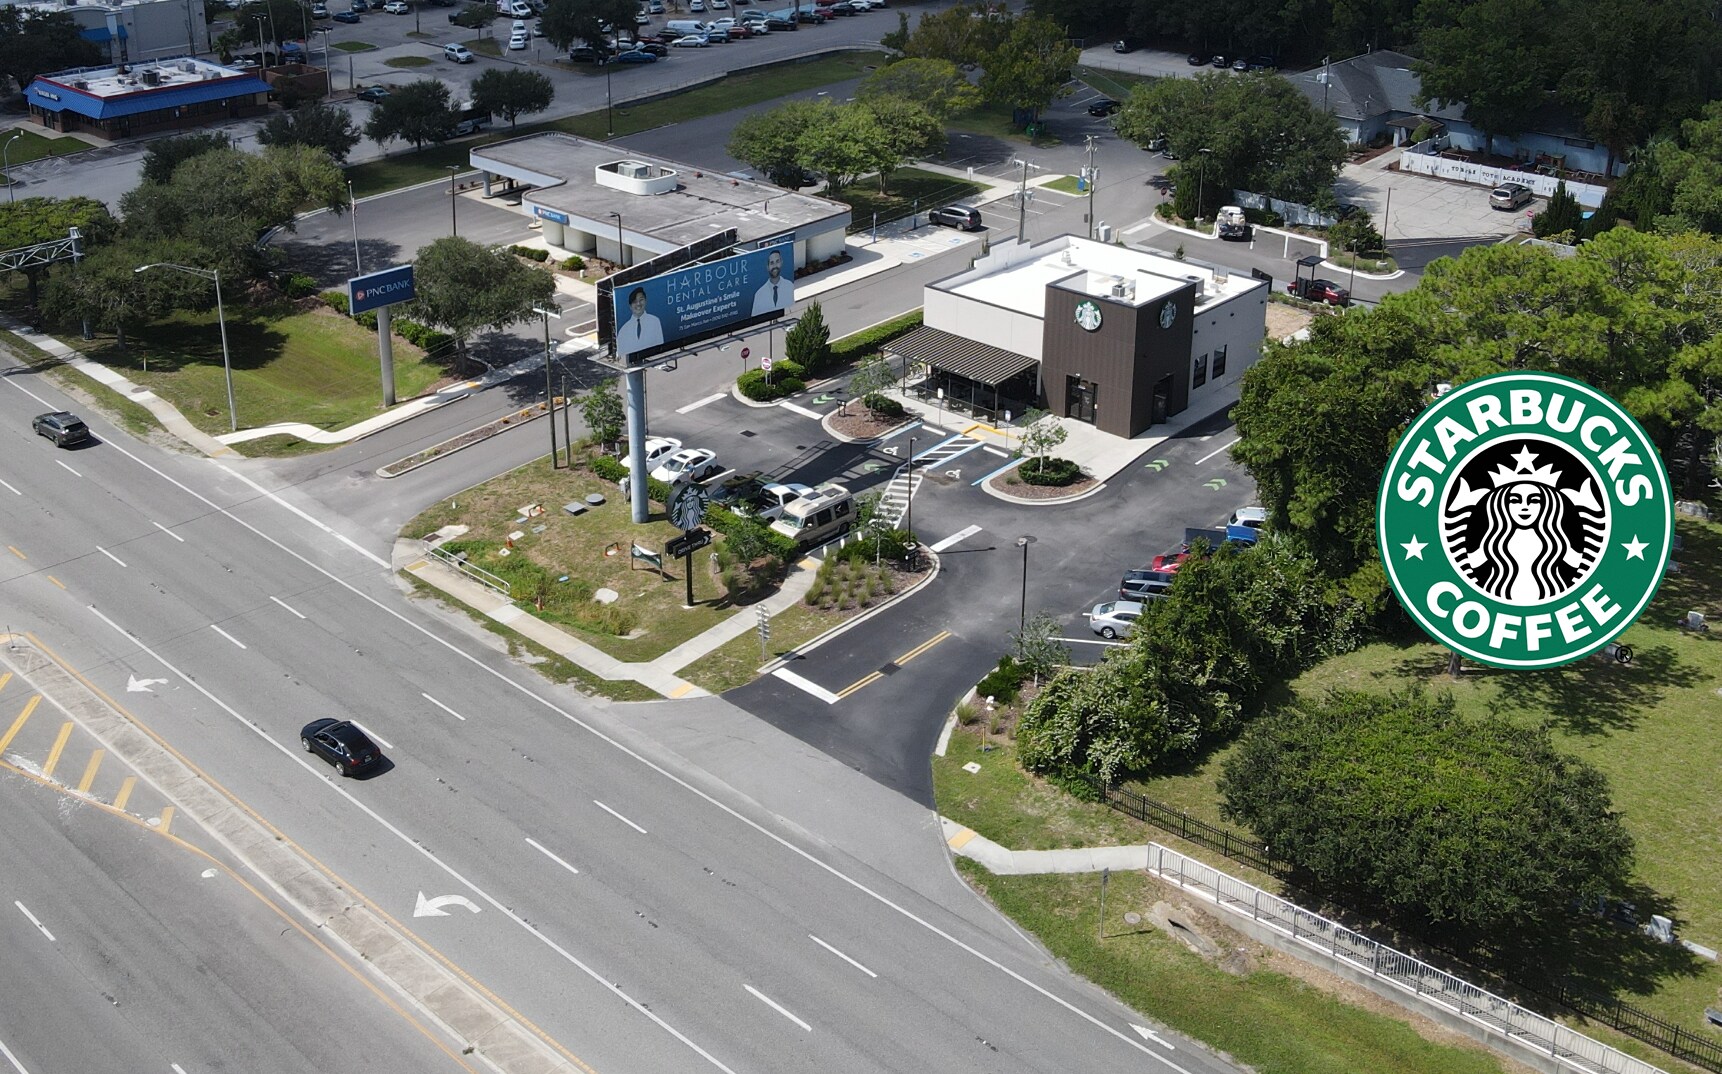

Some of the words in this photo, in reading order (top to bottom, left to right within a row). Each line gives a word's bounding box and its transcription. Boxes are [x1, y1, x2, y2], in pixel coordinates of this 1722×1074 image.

[667, 259, 748, 293] HARBOUR
[667, 285, 711, 305] DENTAL
[718, 274, 748, 291] CARE
[676, 306, 685, 314] St.
[686, 296, 722, 310] Augustine's
[723, 291, 740, 301] Smile
[680, 308, 712, 322] Makeover
[712, 301, 737, 312] Experts
